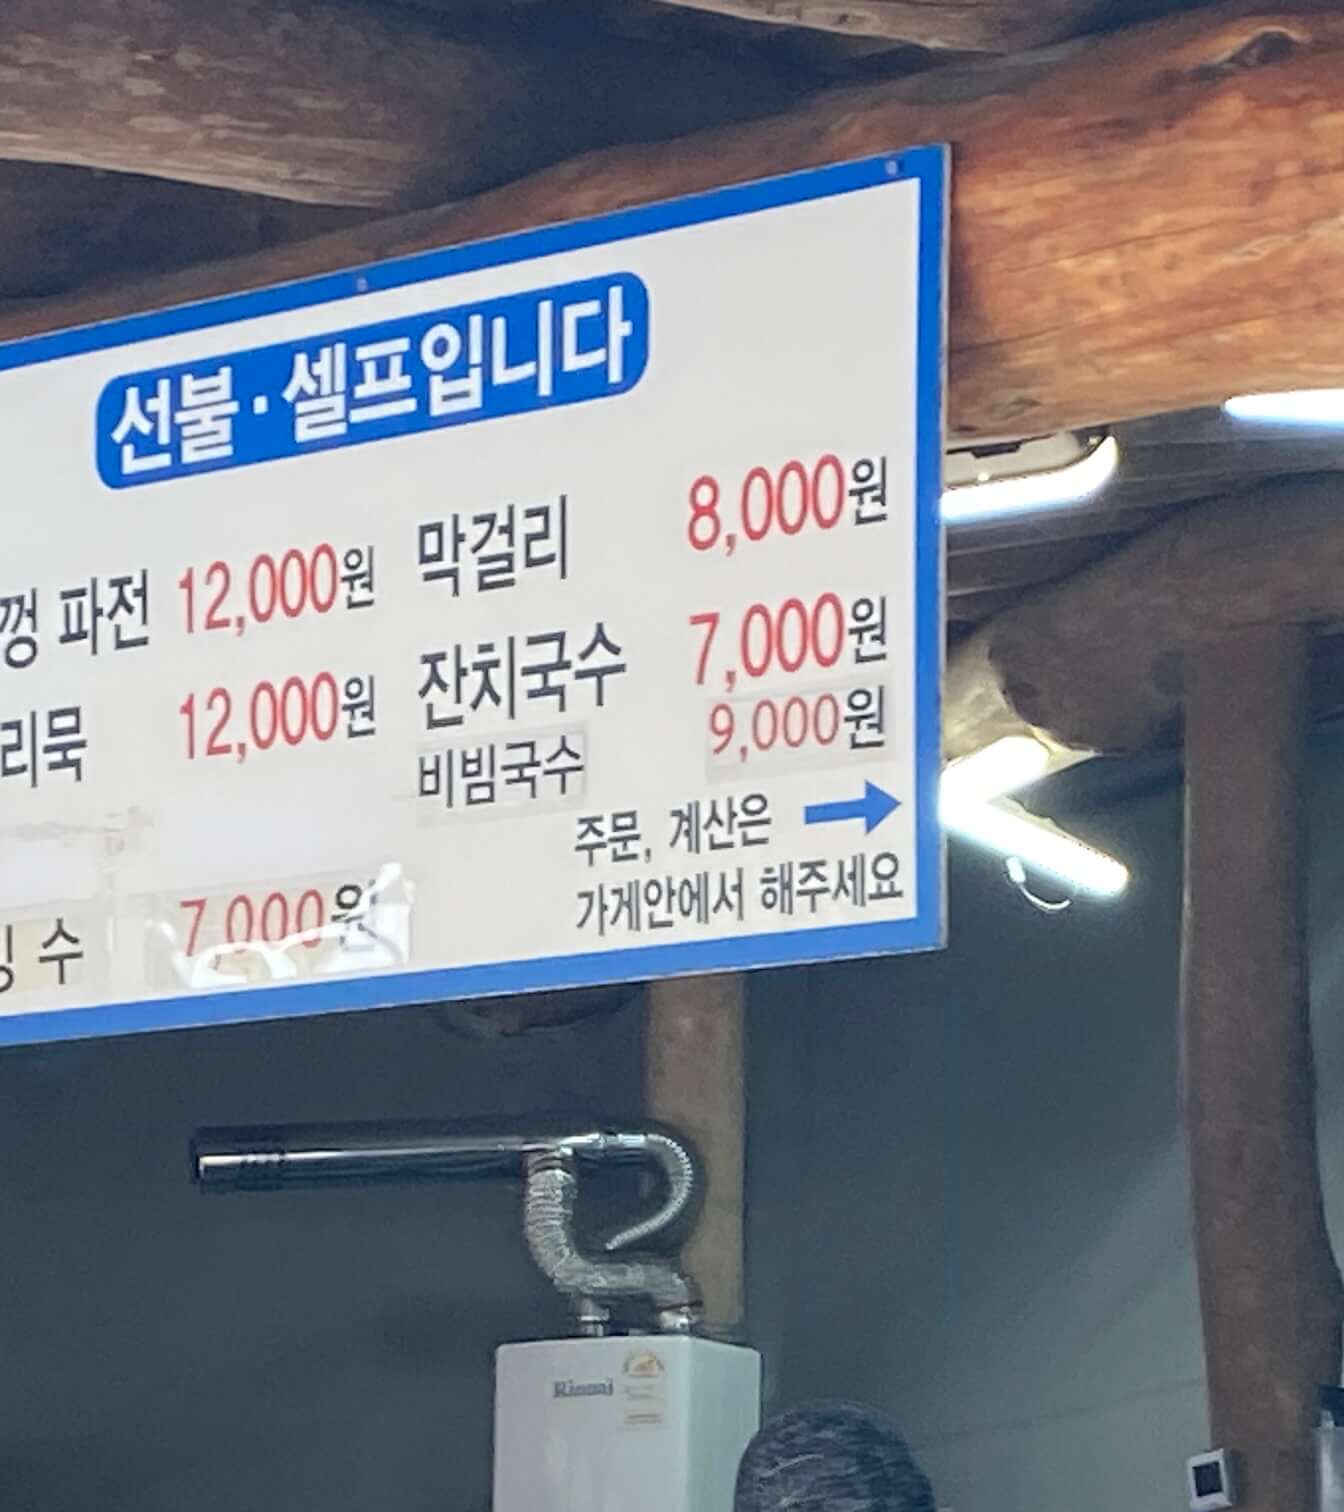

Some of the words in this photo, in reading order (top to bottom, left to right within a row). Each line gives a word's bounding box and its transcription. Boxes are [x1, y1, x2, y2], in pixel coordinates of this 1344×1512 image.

[417, 494, 567, 597] 막걸리
[687, 453, 888, 557] 8,000원
[59, 568, 150, 656] 파전
[177, 542, 376, 637] 12,000원
[417, 622, 626, 729] 잔치국수
[688, 591, 888, 692] 7,000원
[179, 671, 376, 764] 12,000원
[418, 734, 585, 808] 비빔국수
[709, 685, 886, 762] 9,000원
[574, 810, 652, 867] 주문,
[669, 793, 772, 854] 계산은
[576, 866, 744, 936] 가게안에서
[760, 851, 903, 916] 해주세요
